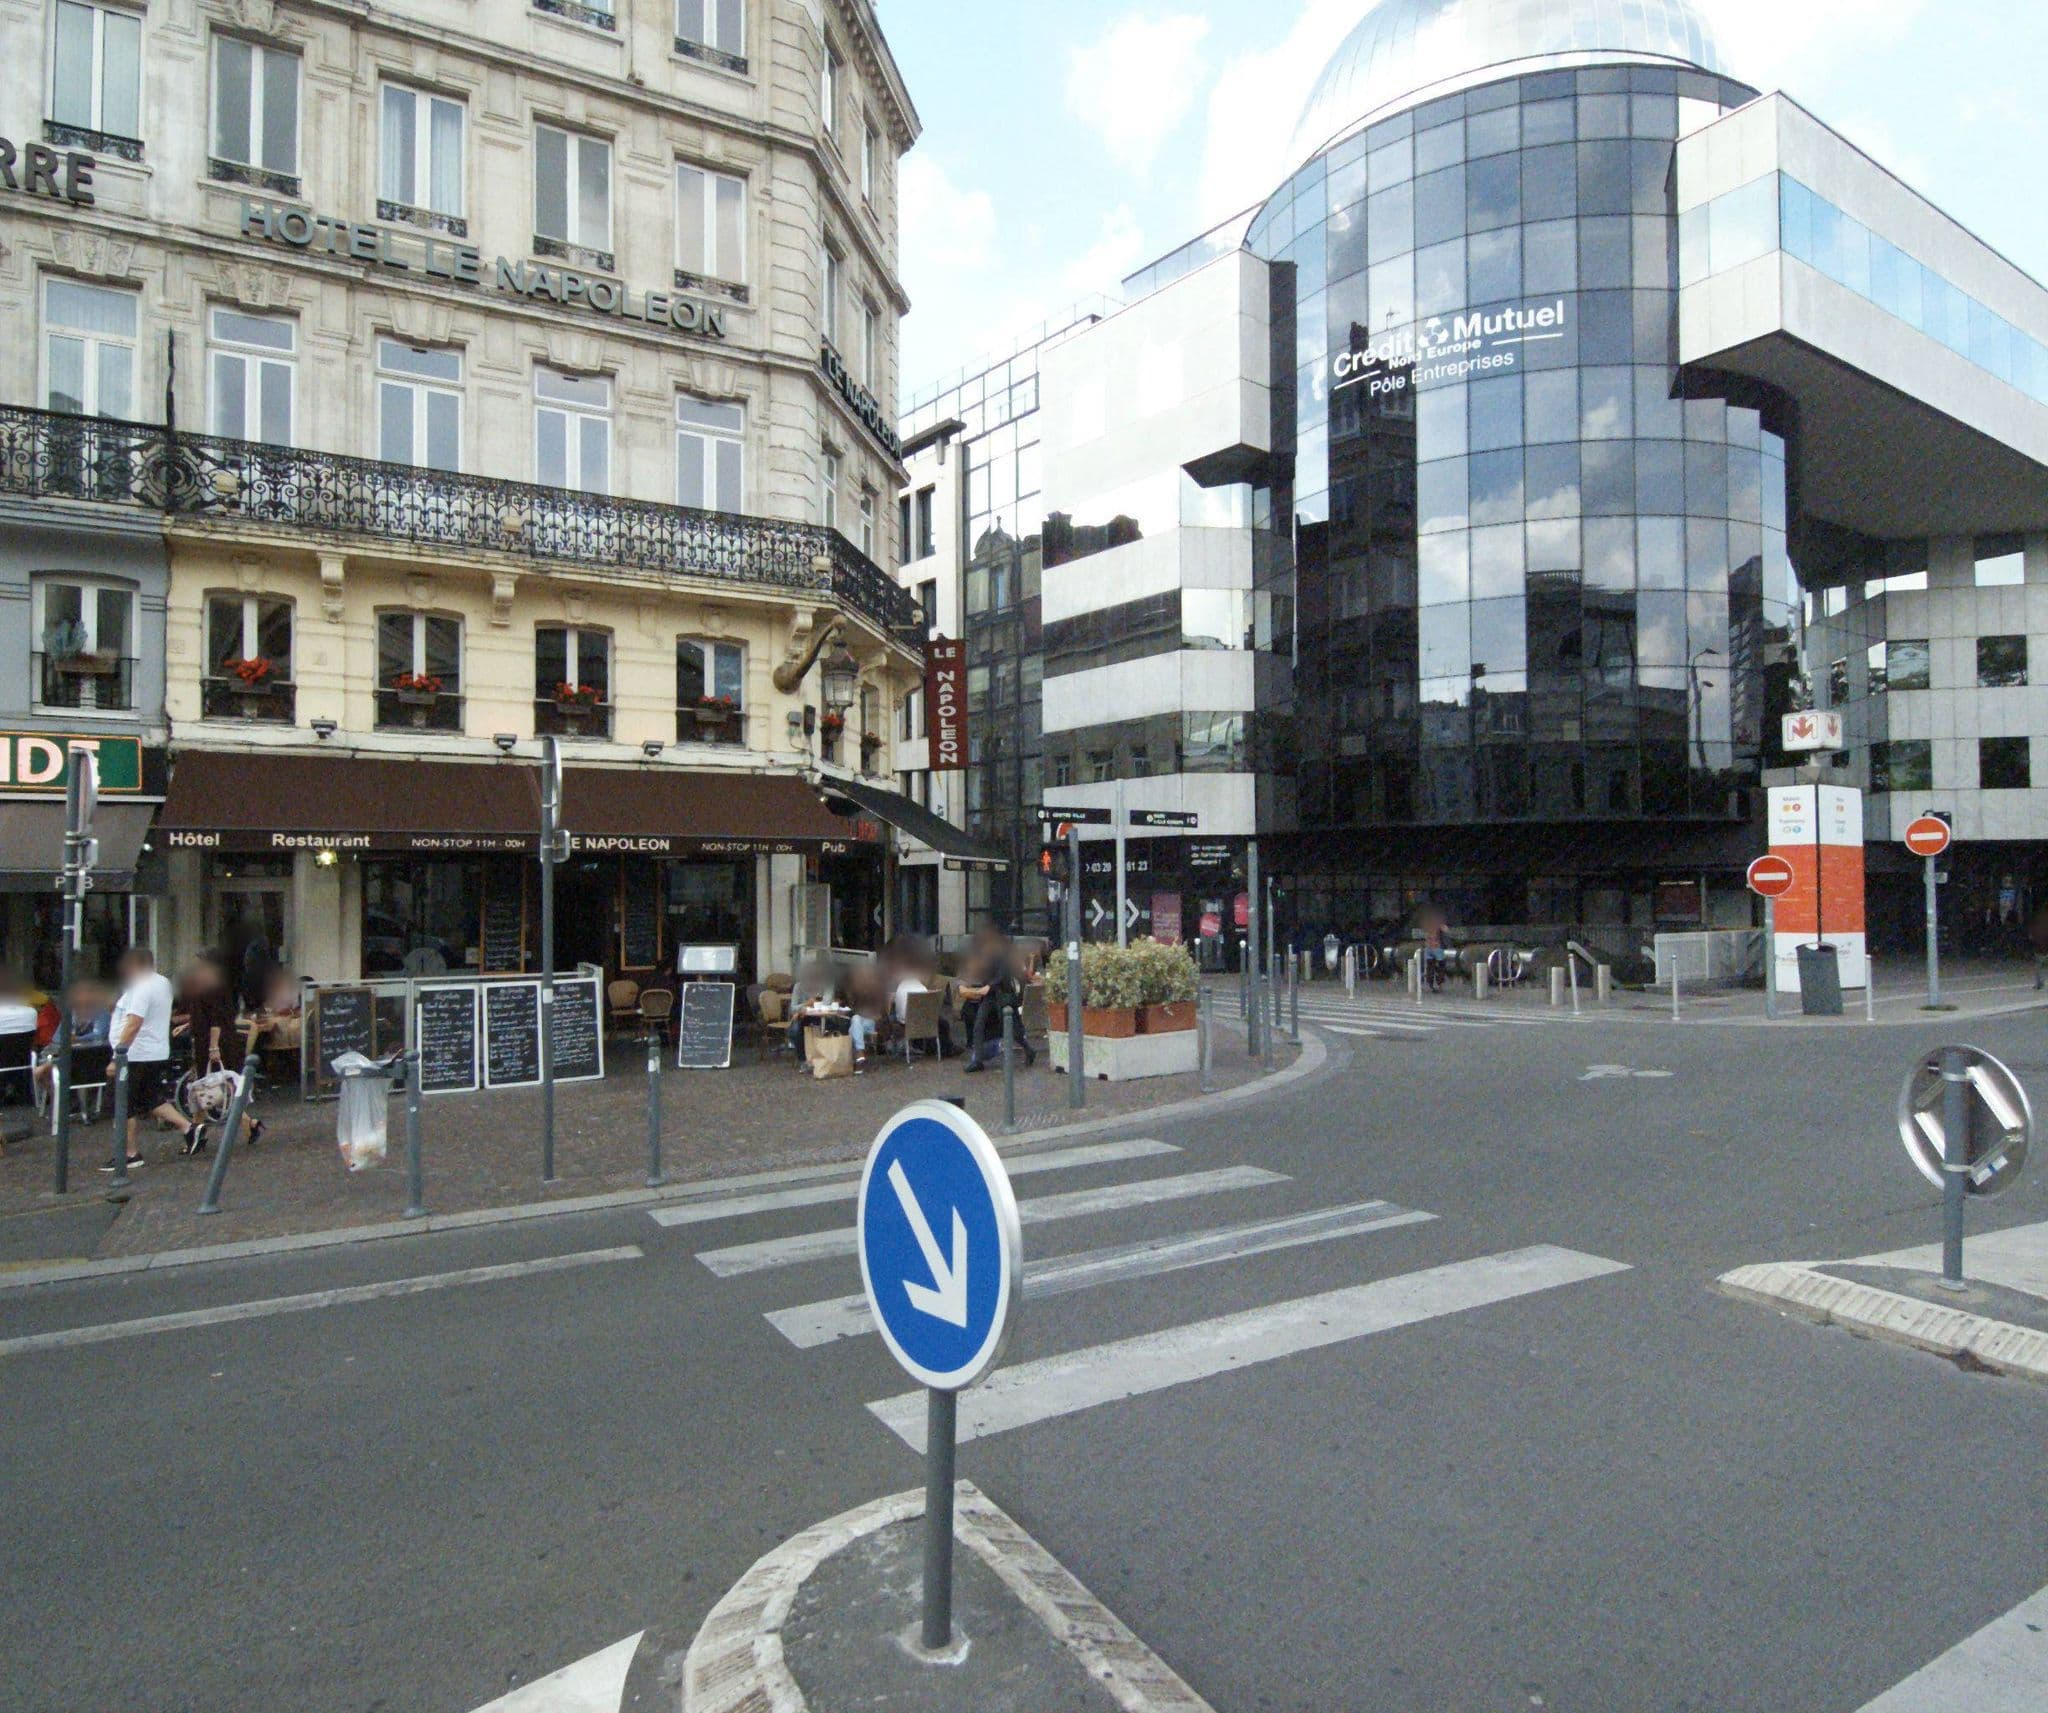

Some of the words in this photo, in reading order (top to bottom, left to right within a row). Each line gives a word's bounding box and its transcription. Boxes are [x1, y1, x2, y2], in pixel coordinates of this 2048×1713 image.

[240, 194, 409, 270] HOTEL
[425, 236, 480, 285] LE
[496, 255, 727, 338] NAPOLEON
[1453, 300, 1564, 341] Mutuel
[1427, 338, 1482, 360] Europe
[1371, 375, 1406, 397] Pôle
[1412, 352, 1514, 386] Entreprises
[933, 646, 956, 659] LE
[936, 669, 958, 764] NAPOLEON
[169, 832, 220, 846] Hôtel
[272, 833, 371, 847] Restaurant
[411, 838, 473, 848] NON-STOP
[585, 837, 670, 850] NAPOLEON
[821, 841, 847, 853] Pub
[55, 877, 94, 889] PB
